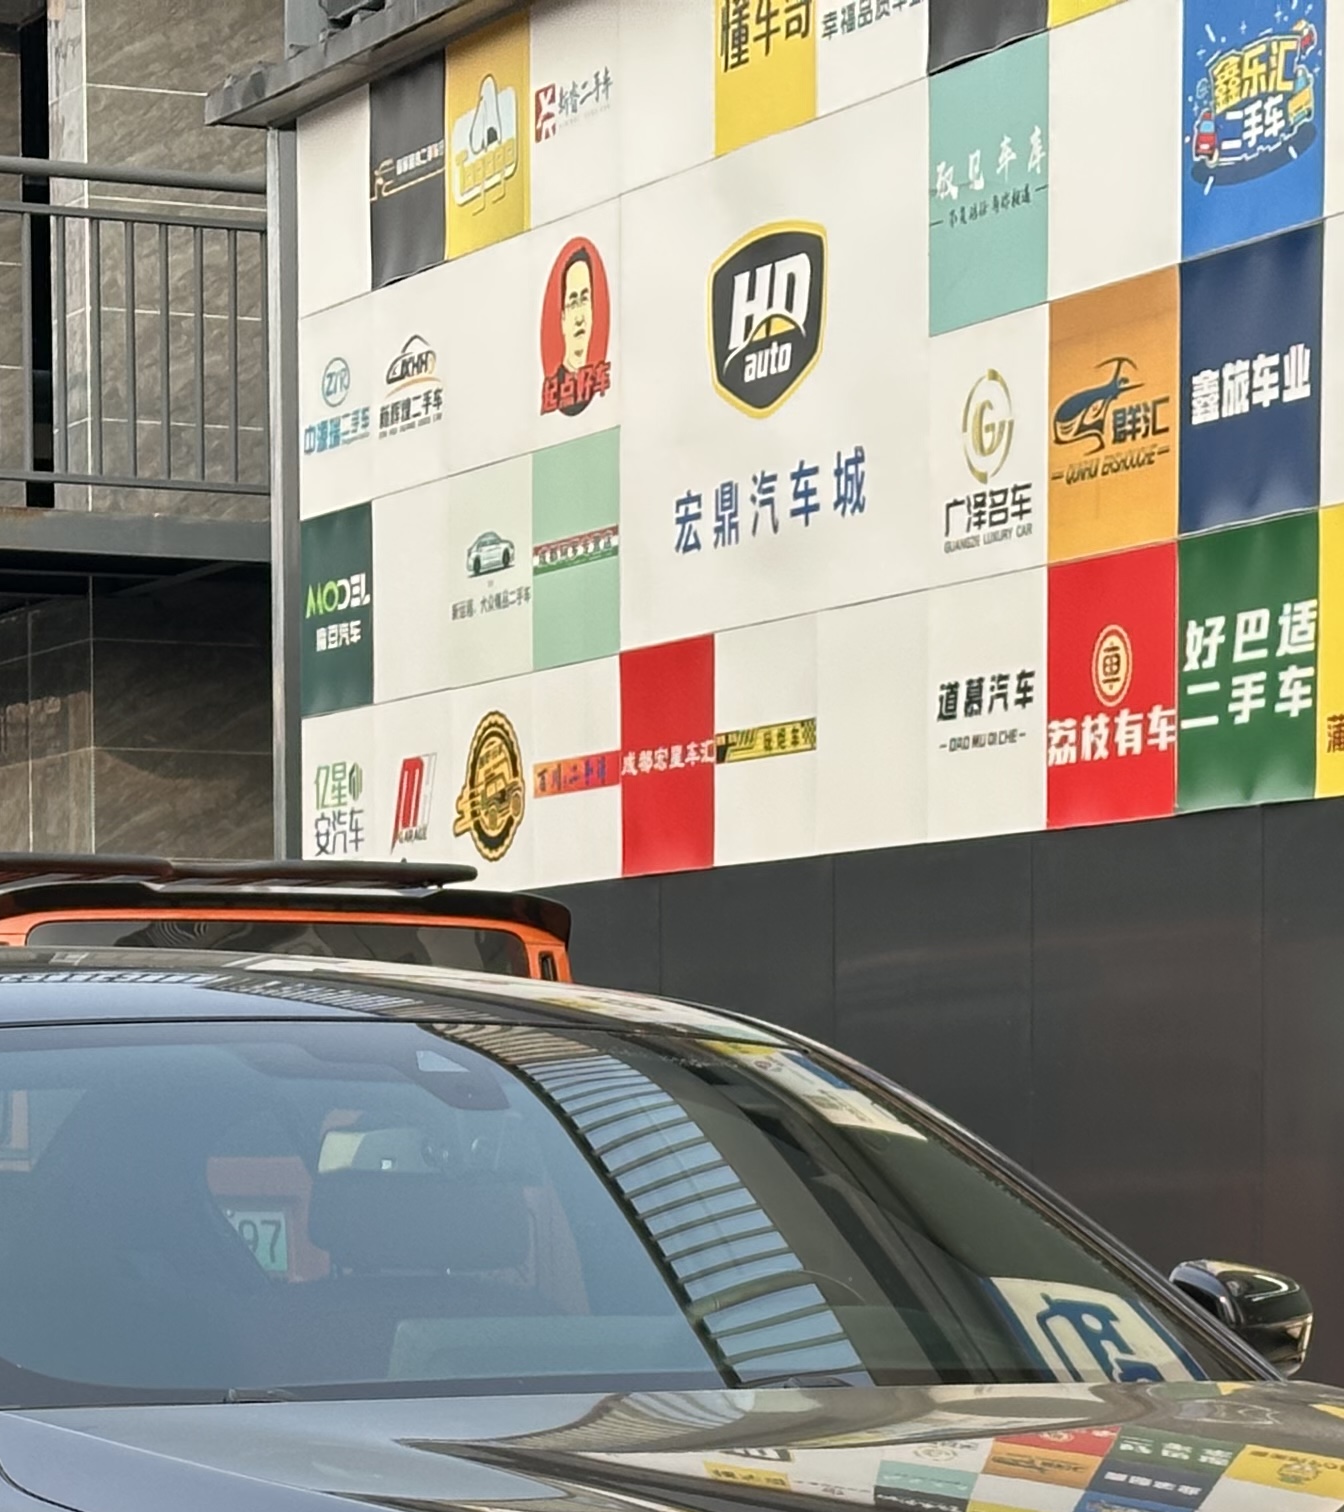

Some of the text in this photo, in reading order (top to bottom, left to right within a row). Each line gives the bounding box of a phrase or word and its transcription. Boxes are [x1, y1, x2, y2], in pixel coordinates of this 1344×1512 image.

[1214, 40, 1298, 113] 鑫乐汇
[1221, 94, 1285, 149] 二手车
[728, 252, 812, 350] HD
[744, 341, 792, 383] auto
[1112, 396, 1170, 444] 群汇
[675, 446, 865, 554] 宏鼎汽车城
[945, 483, 1033, 538] 广泽名车
[1016, 522, 1033, 538] CAR
[1183, 599, 1318, 671] 好巴适
[1180, 665, 1315, 729] 二手车
[1047, 704, 1177, 767] 荔枝有车
[314, 762, 347, 810] 亿星
[314, 807, 365, 857] 安汽车
